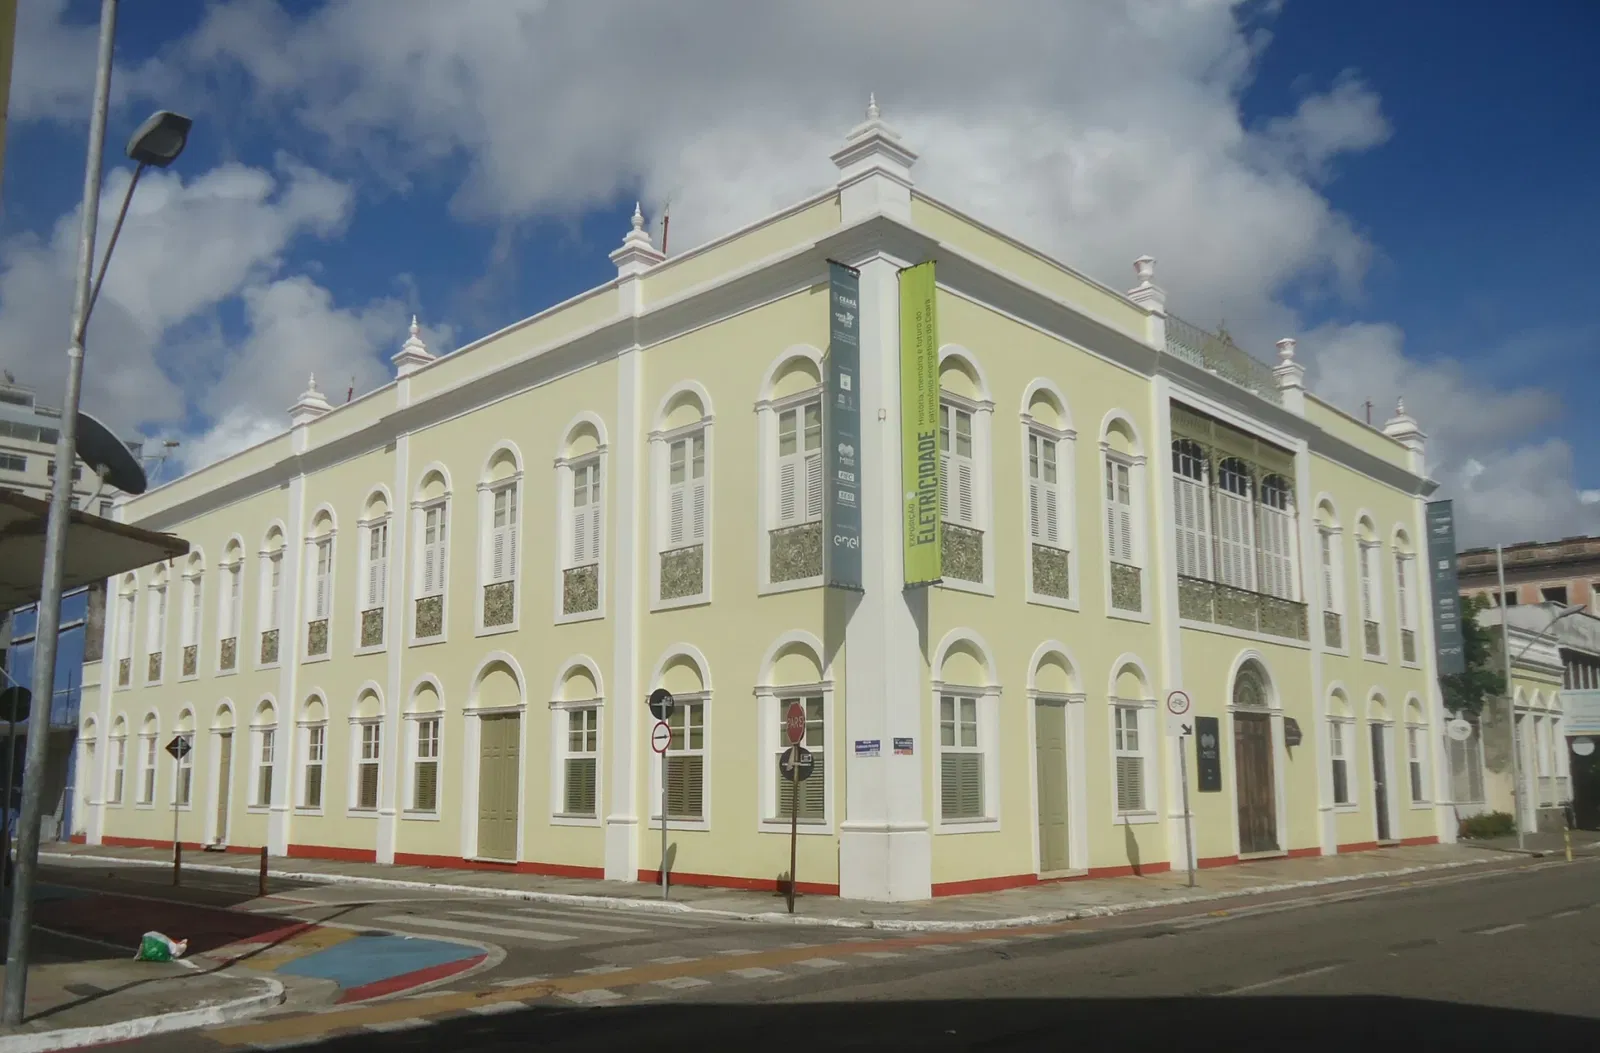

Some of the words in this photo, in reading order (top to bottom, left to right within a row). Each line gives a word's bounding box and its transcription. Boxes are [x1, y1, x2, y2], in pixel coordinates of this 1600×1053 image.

[915, 311, 922, 321] do
[925, 324, 932, 334] do
[926, 335, 934, 379] energético
[926, 379, 935, 423] patrimônio
[917, 394, 925, 426] História,
[834, 534, 859, 549] enel
[787, 715, 804, 729] PARE
